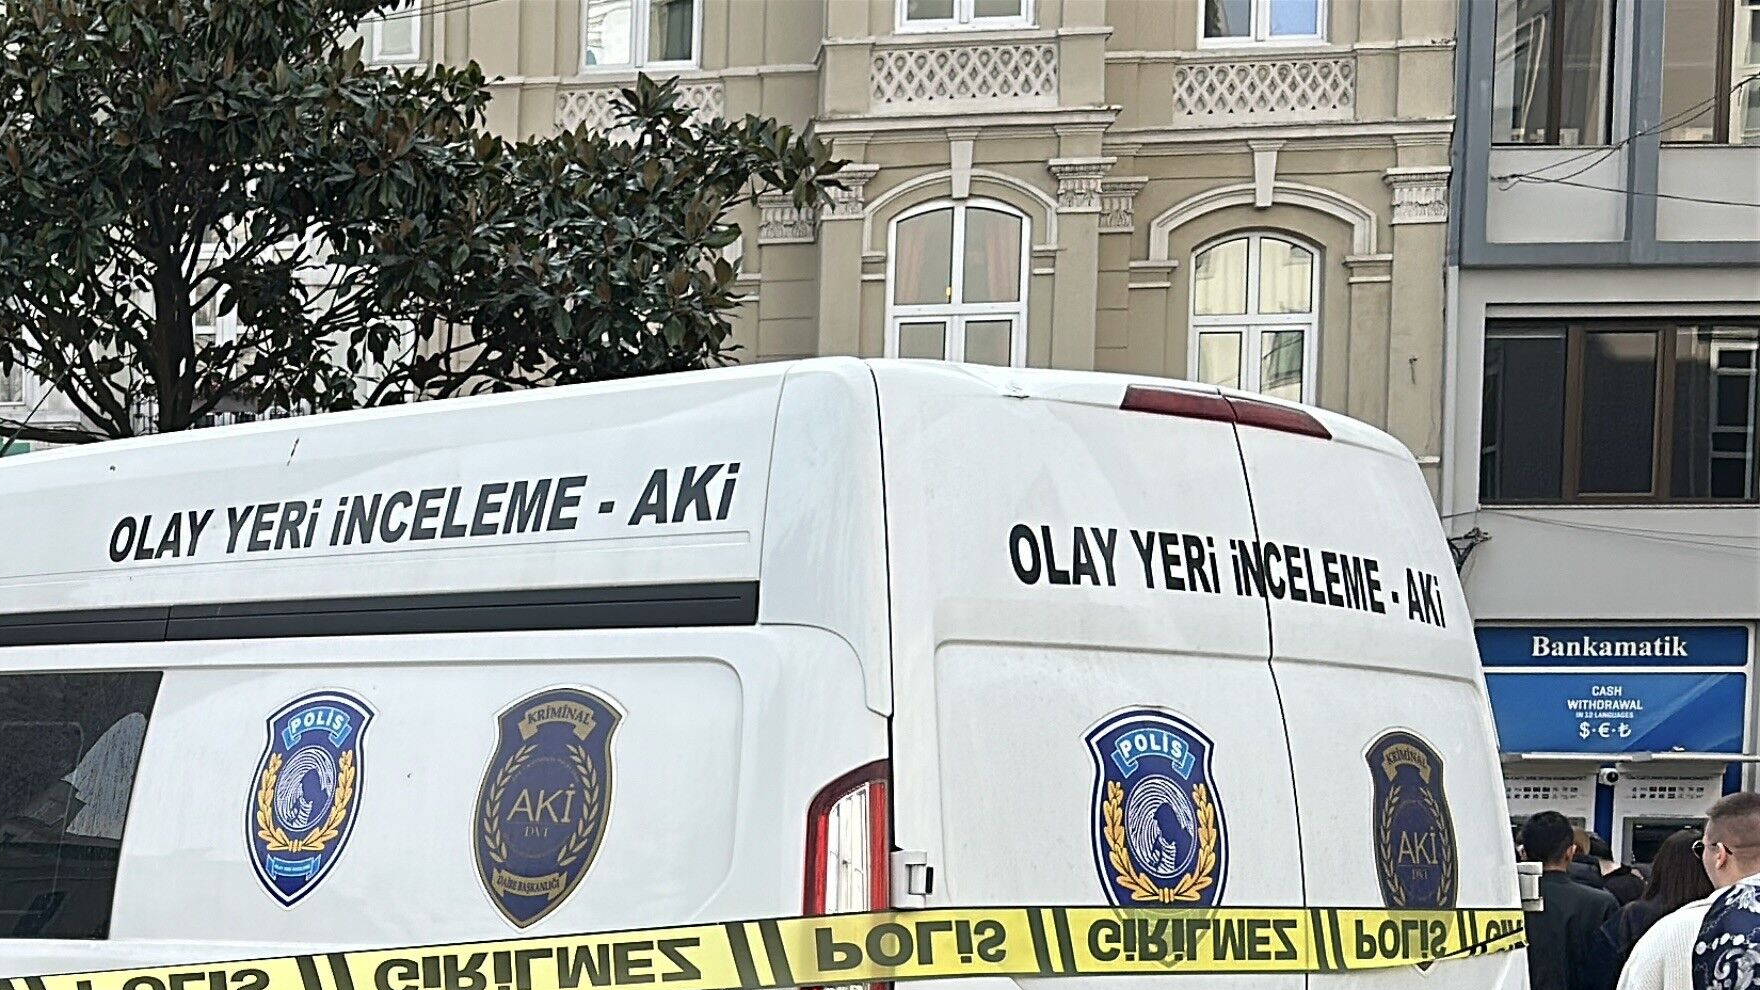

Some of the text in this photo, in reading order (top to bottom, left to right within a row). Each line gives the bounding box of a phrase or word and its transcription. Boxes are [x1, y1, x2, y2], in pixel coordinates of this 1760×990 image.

[108, 508, 216, 563] OLAY
[1009, 523, 1118, 587] OLAY
[1531, 635, 1688, 657] Bankamatik
[1591, 685, 1623, 697] CASH
[1567, 699, 1643, 711] WITHDRAWAL
